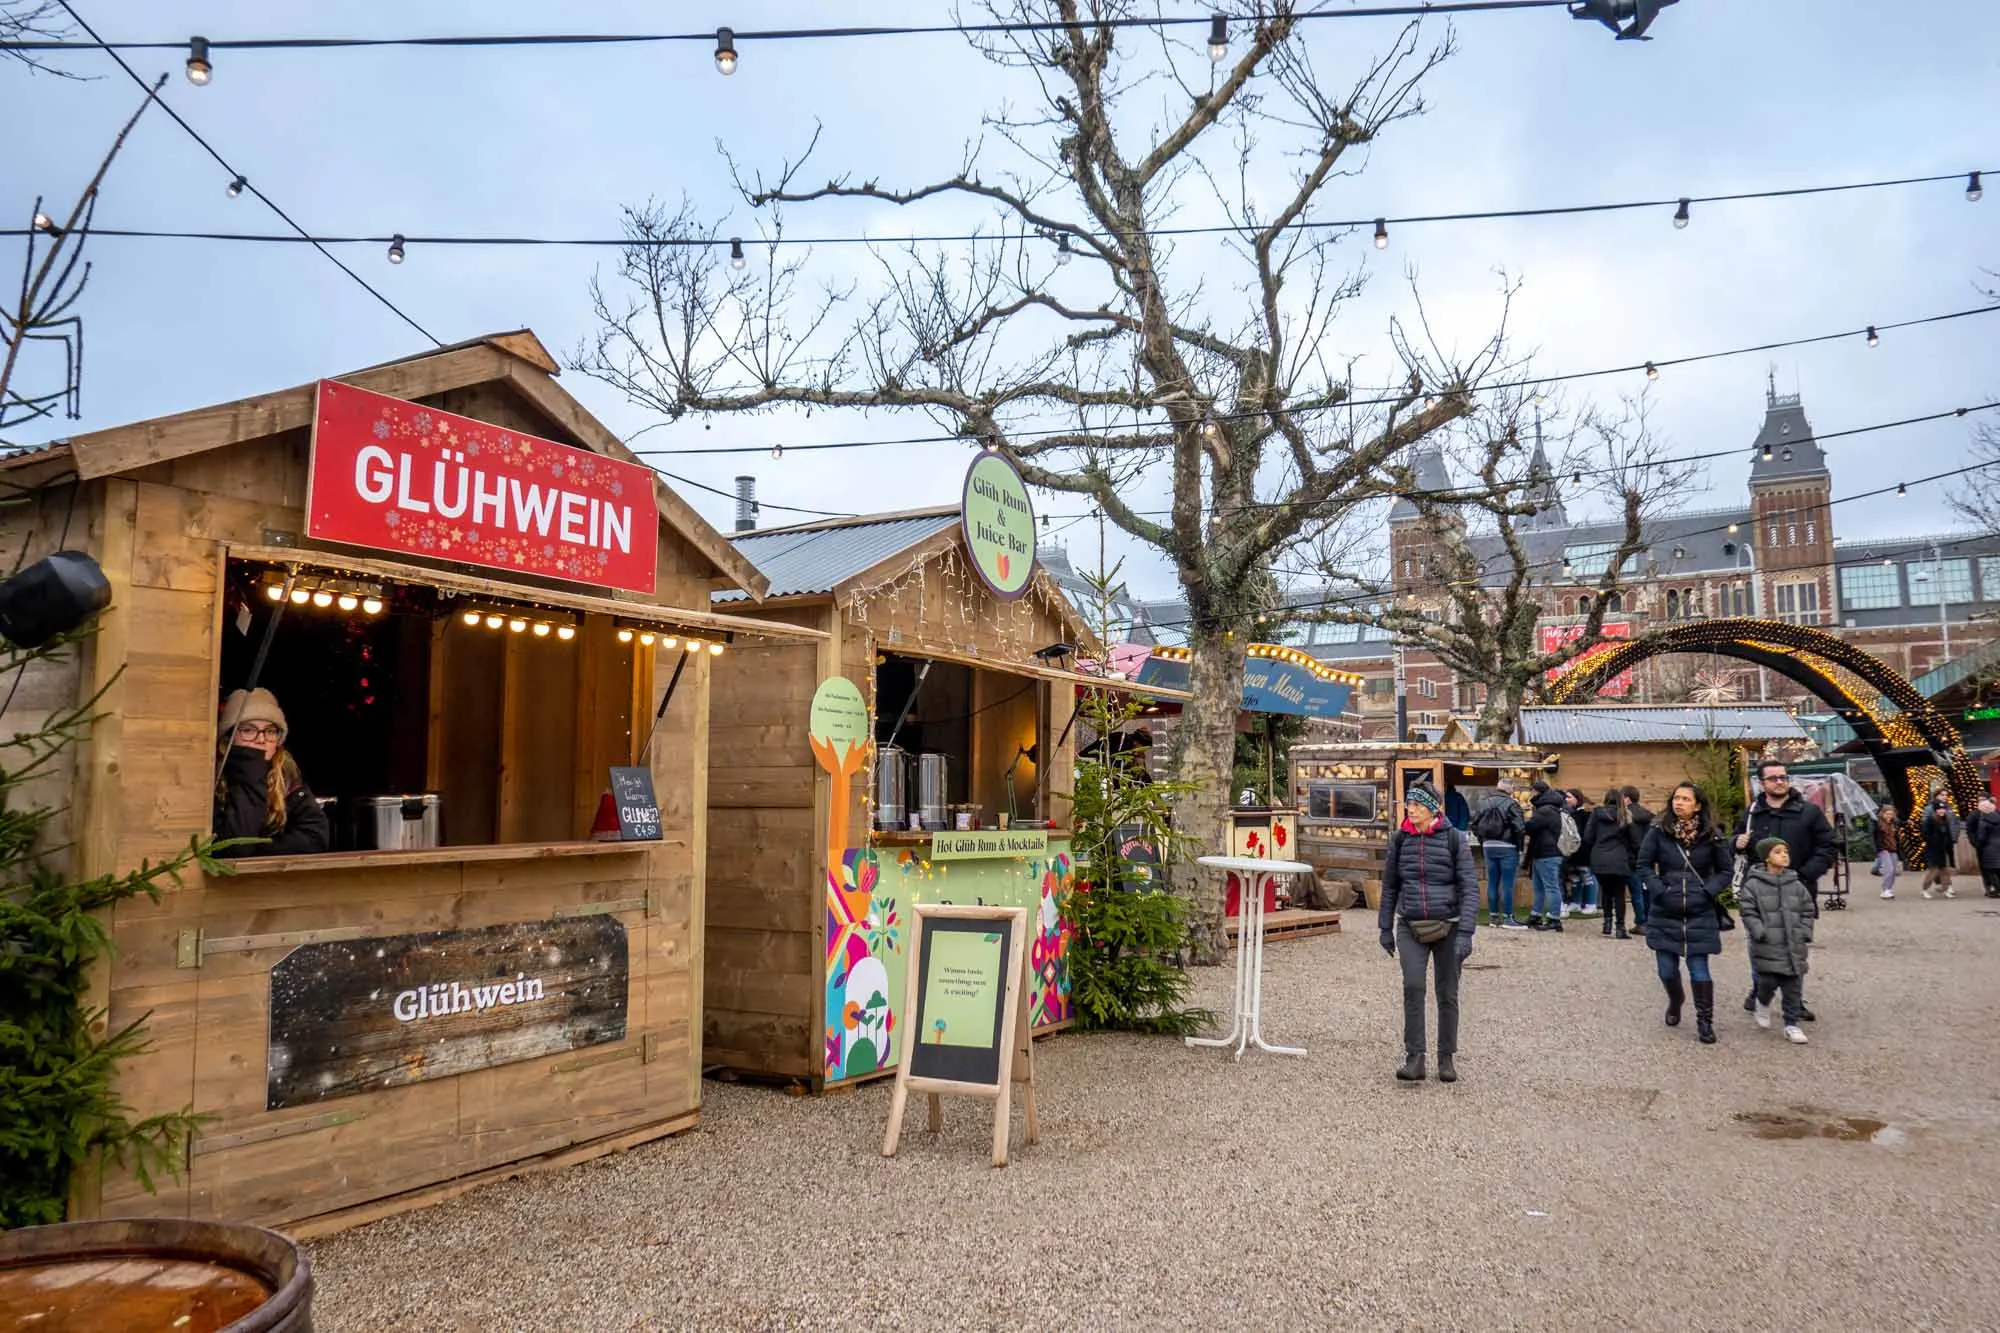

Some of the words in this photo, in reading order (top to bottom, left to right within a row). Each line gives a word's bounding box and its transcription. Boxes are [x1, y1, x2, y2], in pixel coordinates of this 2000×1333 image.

[355, 445, 632, 554] GLÜHWEIN
[973, 476, 999, 503] Glüh
[1003, 489, 1027, 513] Rum
[997, 508, 1006, 527] &
[976, 521, 1005, 546] Juice
[1008, 533, 1027, 554] Bar
[936, 839, 952, 853] Hot
[955, 838, 975, 853] Glüh
[978, 838, 997, 852] Rum
[999, 837, 1006, 851] &
[1007, 836, 1045, 851] Mocktails
[393, 972, 545, 1022] Glühwein
